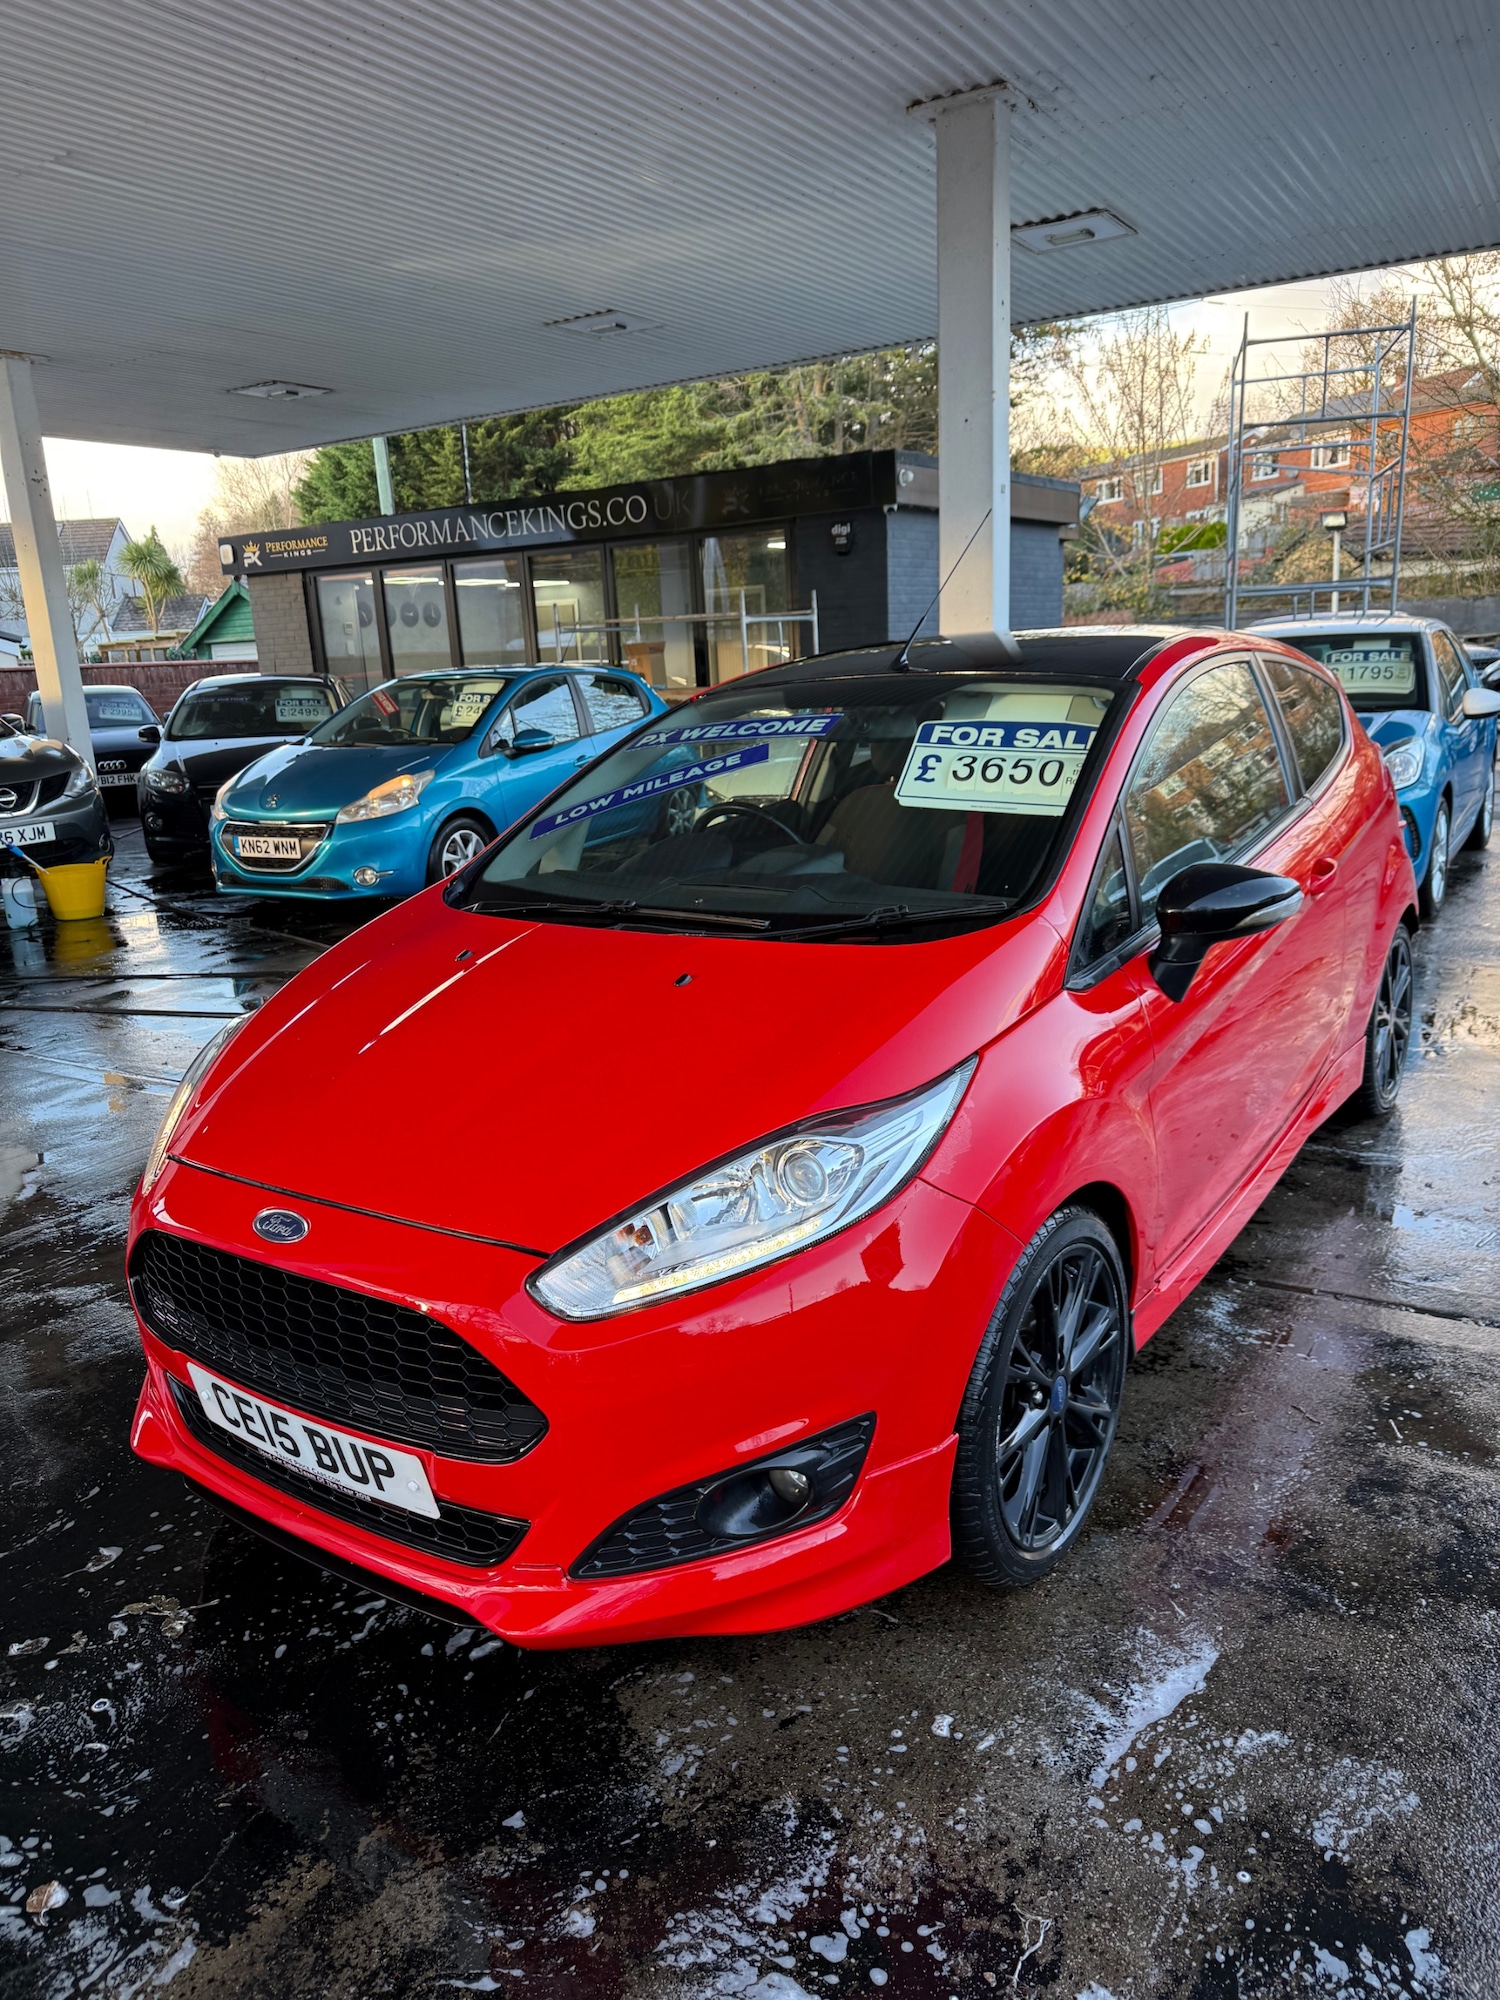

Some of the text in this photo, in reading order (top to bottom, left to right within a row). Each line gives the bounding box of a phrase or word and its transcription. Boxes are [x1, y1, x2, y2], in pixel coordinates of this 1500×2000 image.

[349, 494, 648, 555] PERFORMANCEKINGS.CO
[265, 535, 328, 553] PERFORMANCE
[283, 549, 312, 558] KINGS
[1331, 651, 1410, 662] FOR SALE
[1347, 666, 1394, 680] 1795
[459, 694, 481, 703] FOR
[290, 707, 320, 717] 2495
[633, 717, 832, 748] PX WELCOME
[929, 725, 1005, 747] FOR
[914, 754, 1066, 787] £ 3650
[553, 753, 743, 826] LOW MILEAGE
[17, 825, 47, 843] XJM
[240, 838, 299, 855] KN62 WNM
[262, 1213, 298, 1237] Ford
[210, 1381, 396, 1493] CE15 BUP
